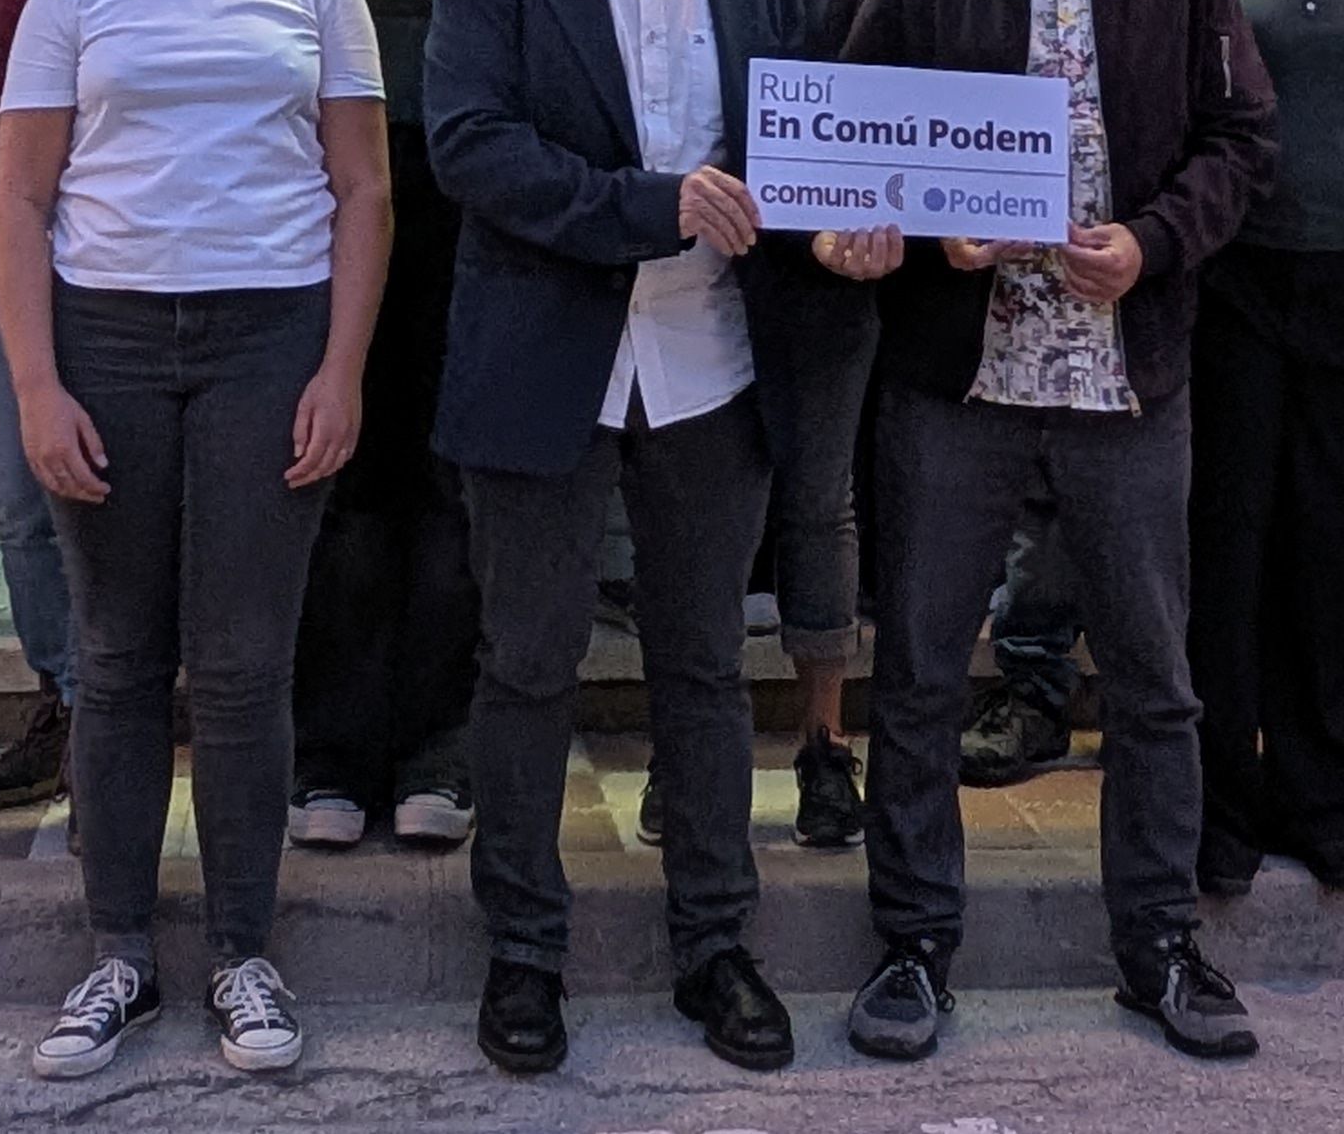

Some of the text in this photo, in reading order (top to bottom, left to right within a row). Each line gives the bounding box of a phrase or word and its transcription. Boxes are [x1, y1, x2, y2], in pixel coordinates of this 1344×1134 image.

[760, 72, 835, 104] Rubí
[758, 109, 1053, 155] En Comú Podem
[760, 183, 878, 210] comuns
[949, 188, 1048, 218] Podem
